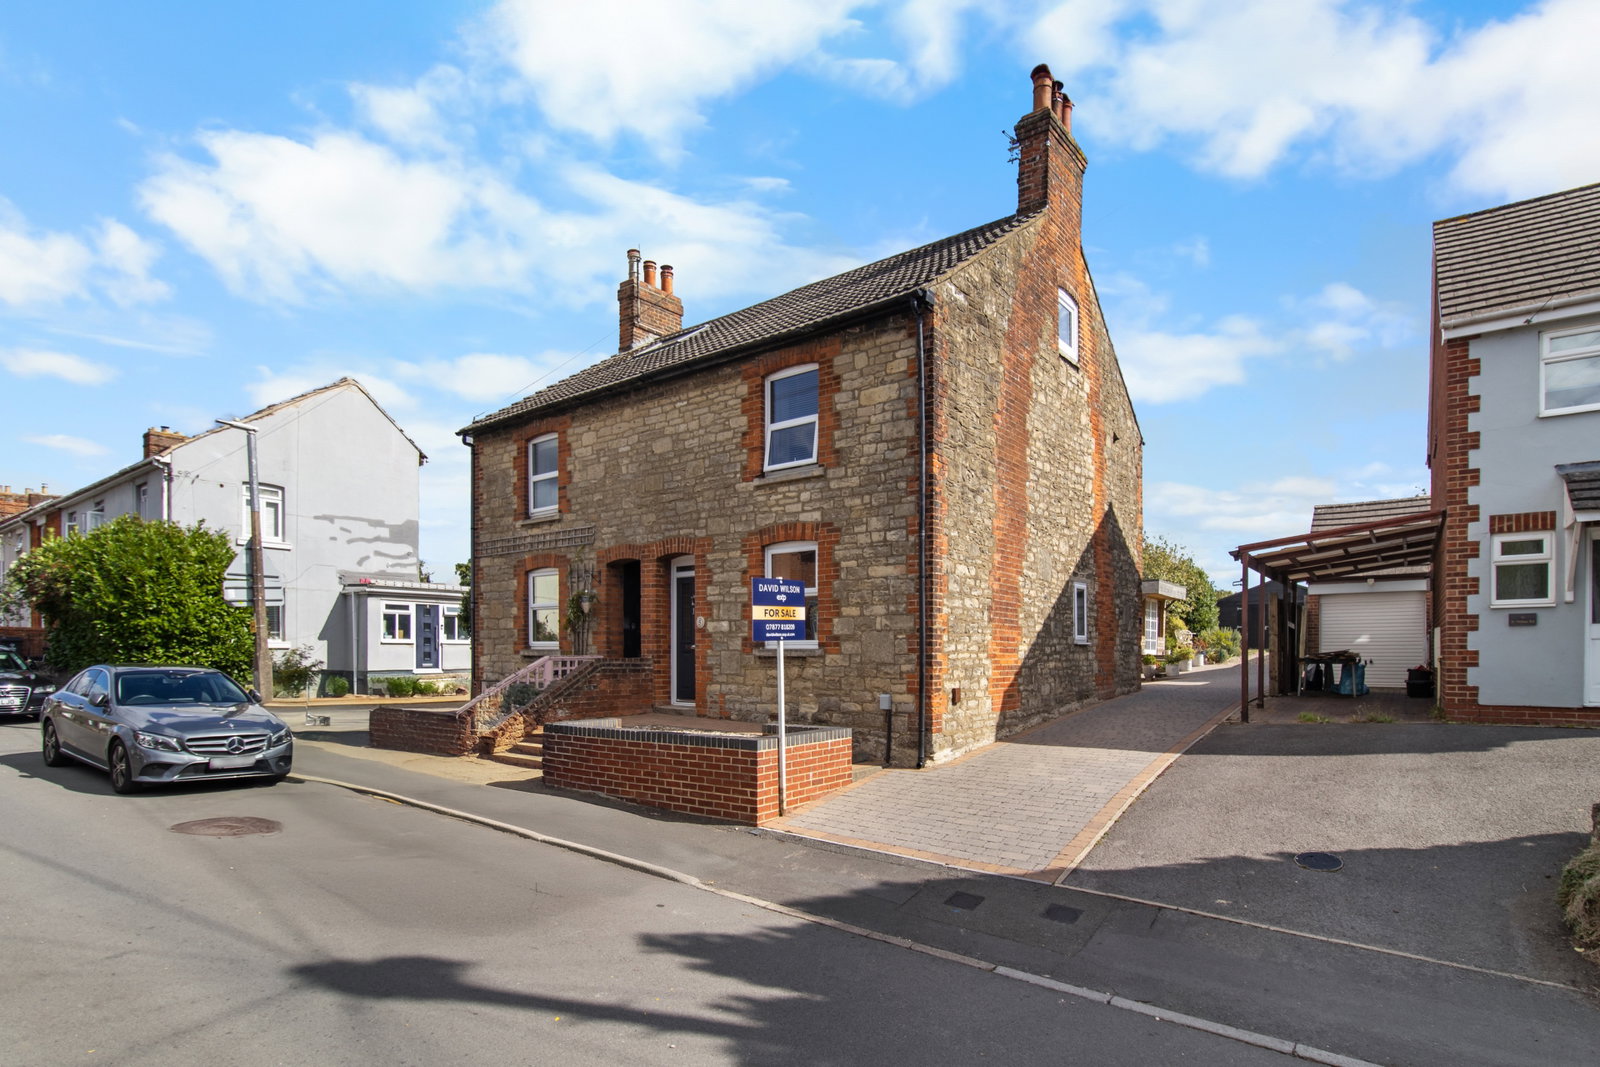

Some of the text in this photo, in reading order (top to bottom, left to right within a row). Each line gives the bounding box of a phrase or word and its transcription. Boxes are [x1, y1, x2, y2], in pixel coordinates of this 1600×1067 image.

[759, 584, 800, 593] DAVID WILSON
[764, 609, 796, 617] FOR SALE
